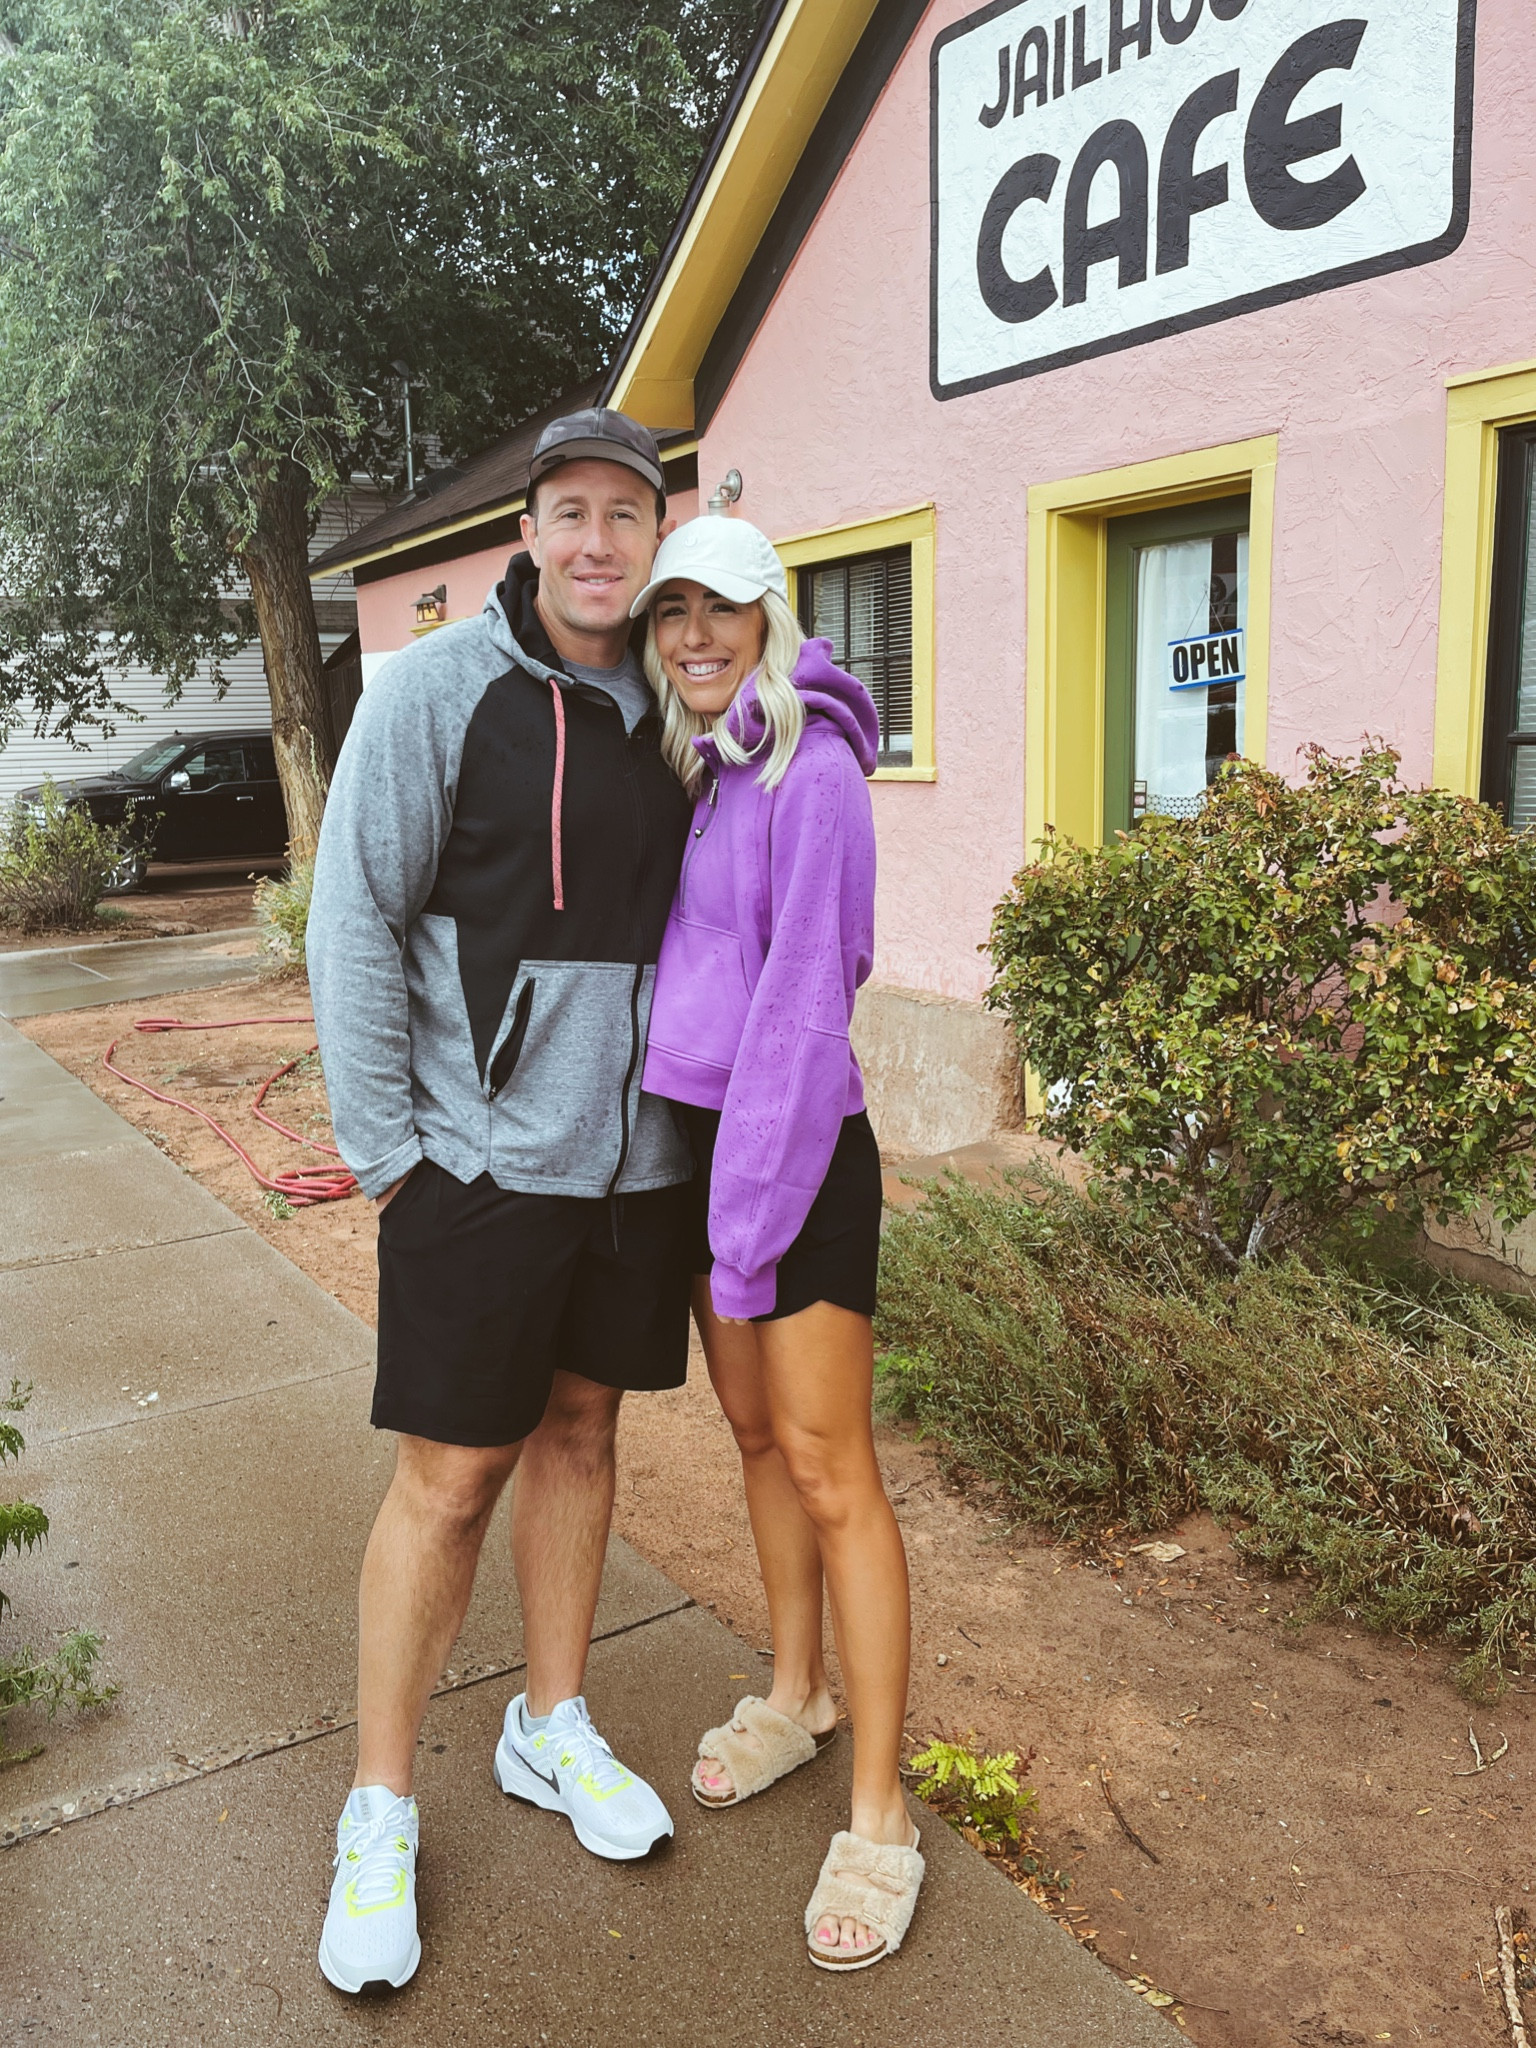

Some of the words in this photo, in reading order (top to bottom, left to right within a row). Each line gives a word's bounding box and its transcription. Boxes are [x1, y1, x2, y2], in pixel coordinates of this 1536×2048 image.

[978, 0, 1248, 129] JAILHO
[977, 19, 1368, 323] CAFE
[1173, 636, 1239, 683] OPEN
